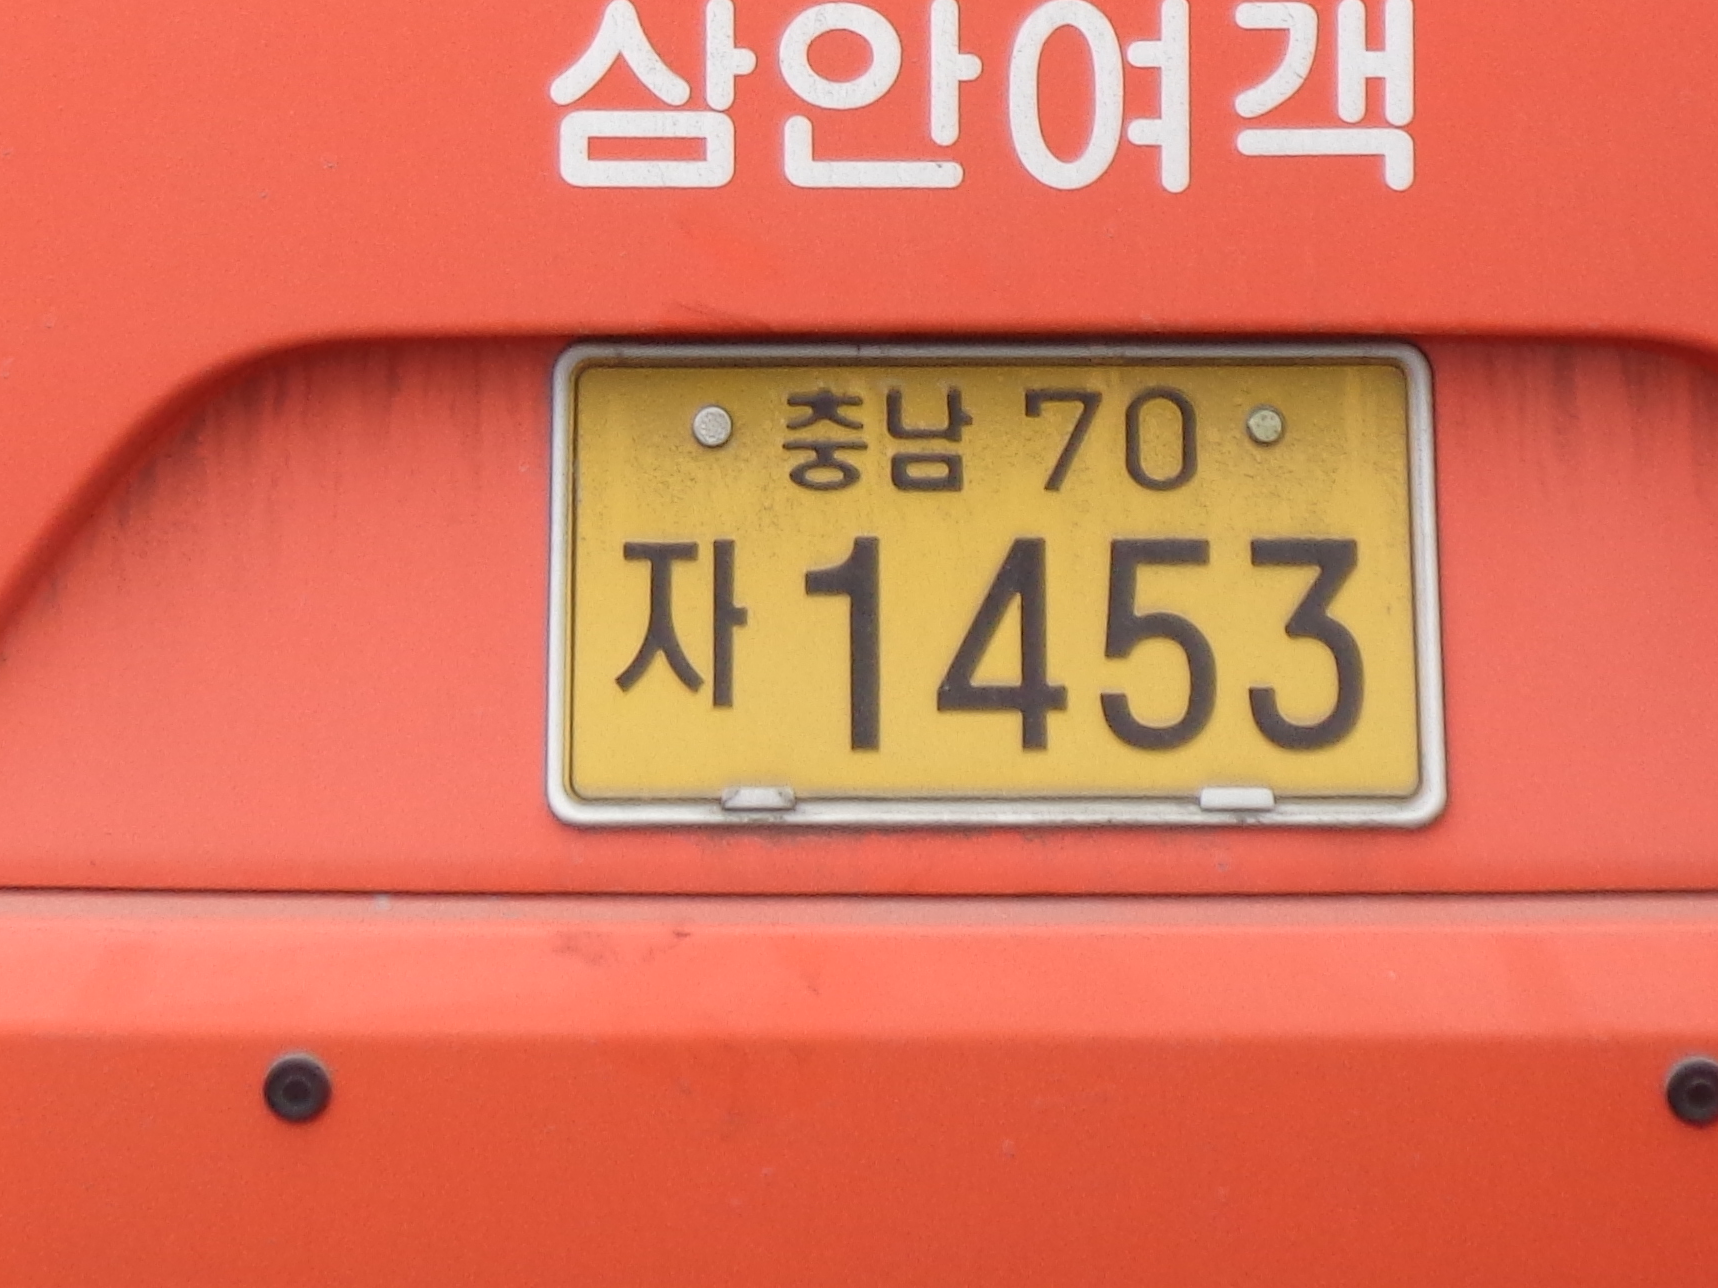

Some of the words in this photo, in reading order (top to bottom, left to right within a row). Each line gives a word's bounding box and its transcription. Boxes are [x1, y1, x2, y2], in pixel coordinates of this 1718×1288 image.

[781, 387, 973, 493] 충남
[1024, 386, 1197, 493] 70
[614, 538, 748, 708] 자
[803, 536, 1365, 753] 1453
